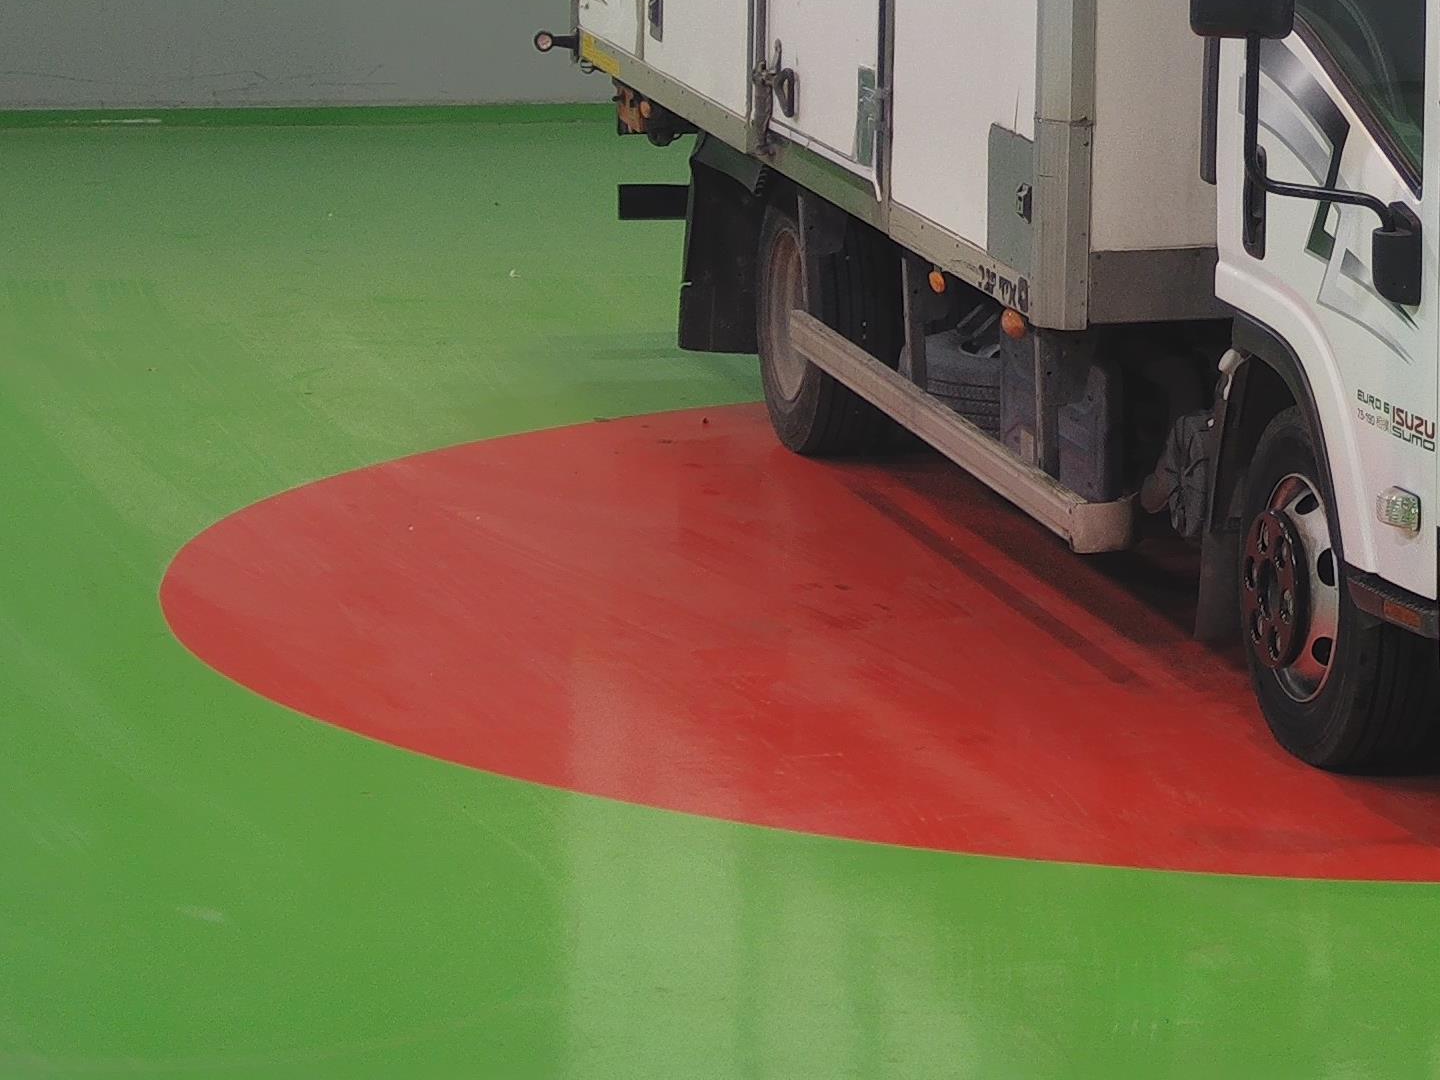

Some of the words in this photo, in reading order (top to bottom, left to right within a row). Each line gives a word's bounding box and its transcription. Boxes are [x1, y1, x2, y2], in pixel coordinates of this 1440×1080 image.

[1357, 389, 1382, 410] EURO
[1383, 401, 1390, 415] 6
[1392, 405, 1436, 440] ISUZU
[1391, 425, 1436, 452] SUMO
